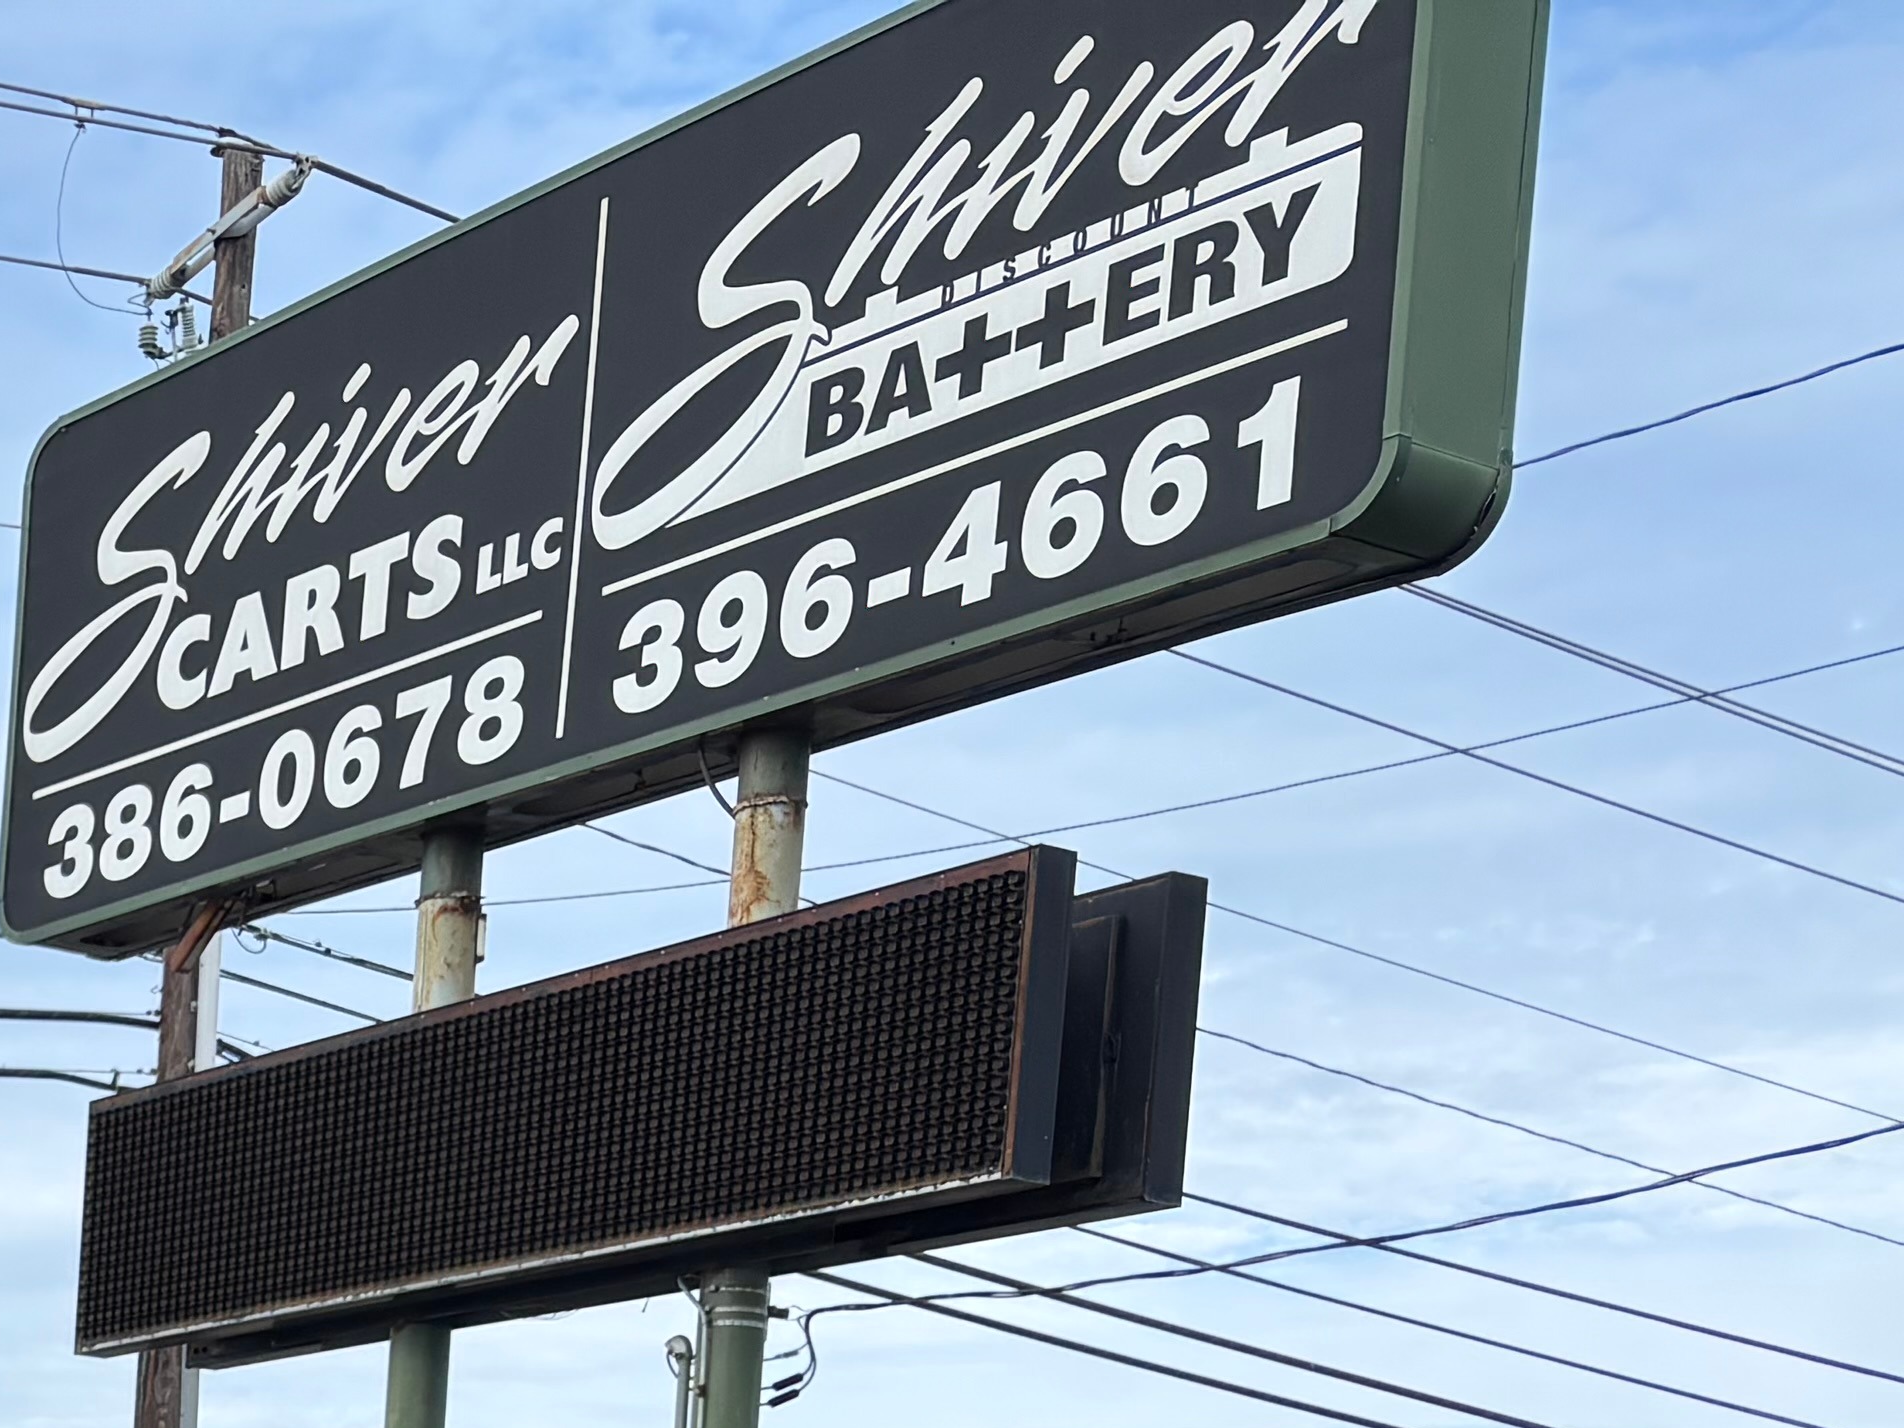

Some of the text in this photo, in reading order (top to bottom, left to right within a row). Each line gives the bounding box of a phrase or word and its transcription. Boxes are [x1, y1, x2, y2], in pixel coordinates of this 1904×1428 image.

[592, 0, 1379, 551] Shiver
[23, 314, 580, 763] Shiver
[156, 513, 564, 711] CARTS LLC
[611, 375, 1302, 715] 396-4661
[43, 655, 526, 900] 386-0678
